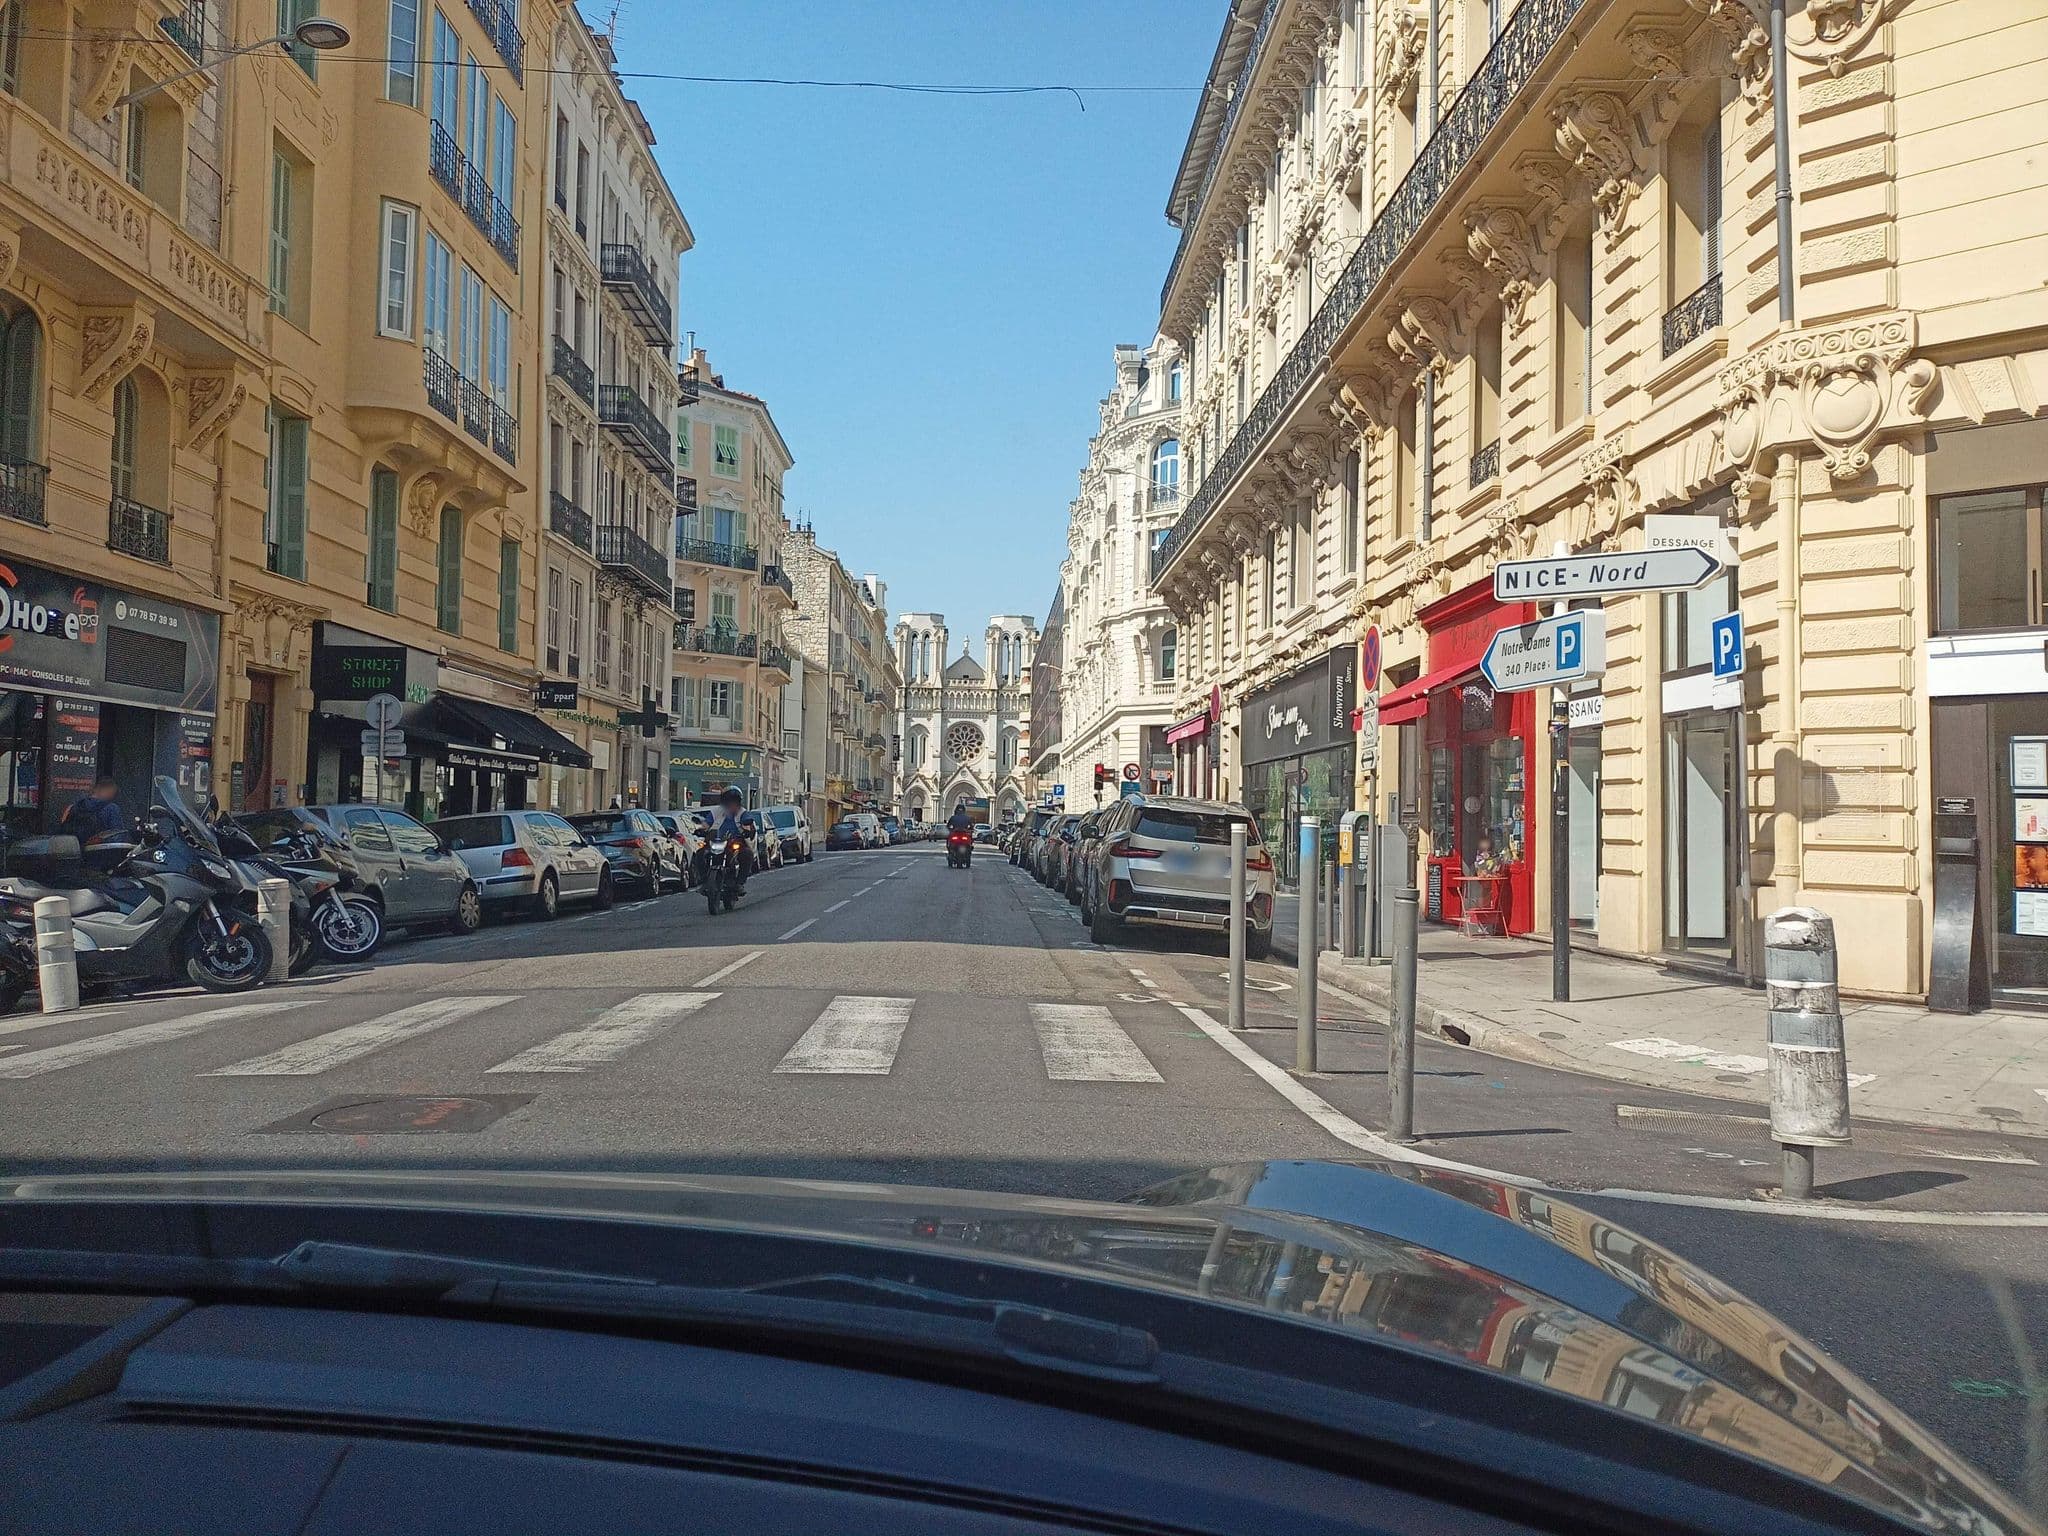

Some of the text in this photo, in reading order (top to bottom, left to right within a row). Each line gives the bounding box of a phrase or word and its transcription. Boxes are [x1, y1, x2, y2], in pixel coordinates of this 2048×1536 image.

[1652, 537, 1715, 549] DESSANGE
[129, 607, 138, 617] 07
[139, 609, 148, 620] 78
[149, 612, 158, 622] 57
[1719, 627, 1734, 666] P
[343, 657, 402, 671] STREET
[1505, 663, 1521, 677] 340
[13, 666, 29, 677] MAC
[31, 669, 65, 683] CONSOLES
[65, 674, 74, 684] DE
[352, 676, 392, 689] SHOP
[1333, 675, 1344, 729] Showroom
[1569, 698, 1602, 719] SSANG
